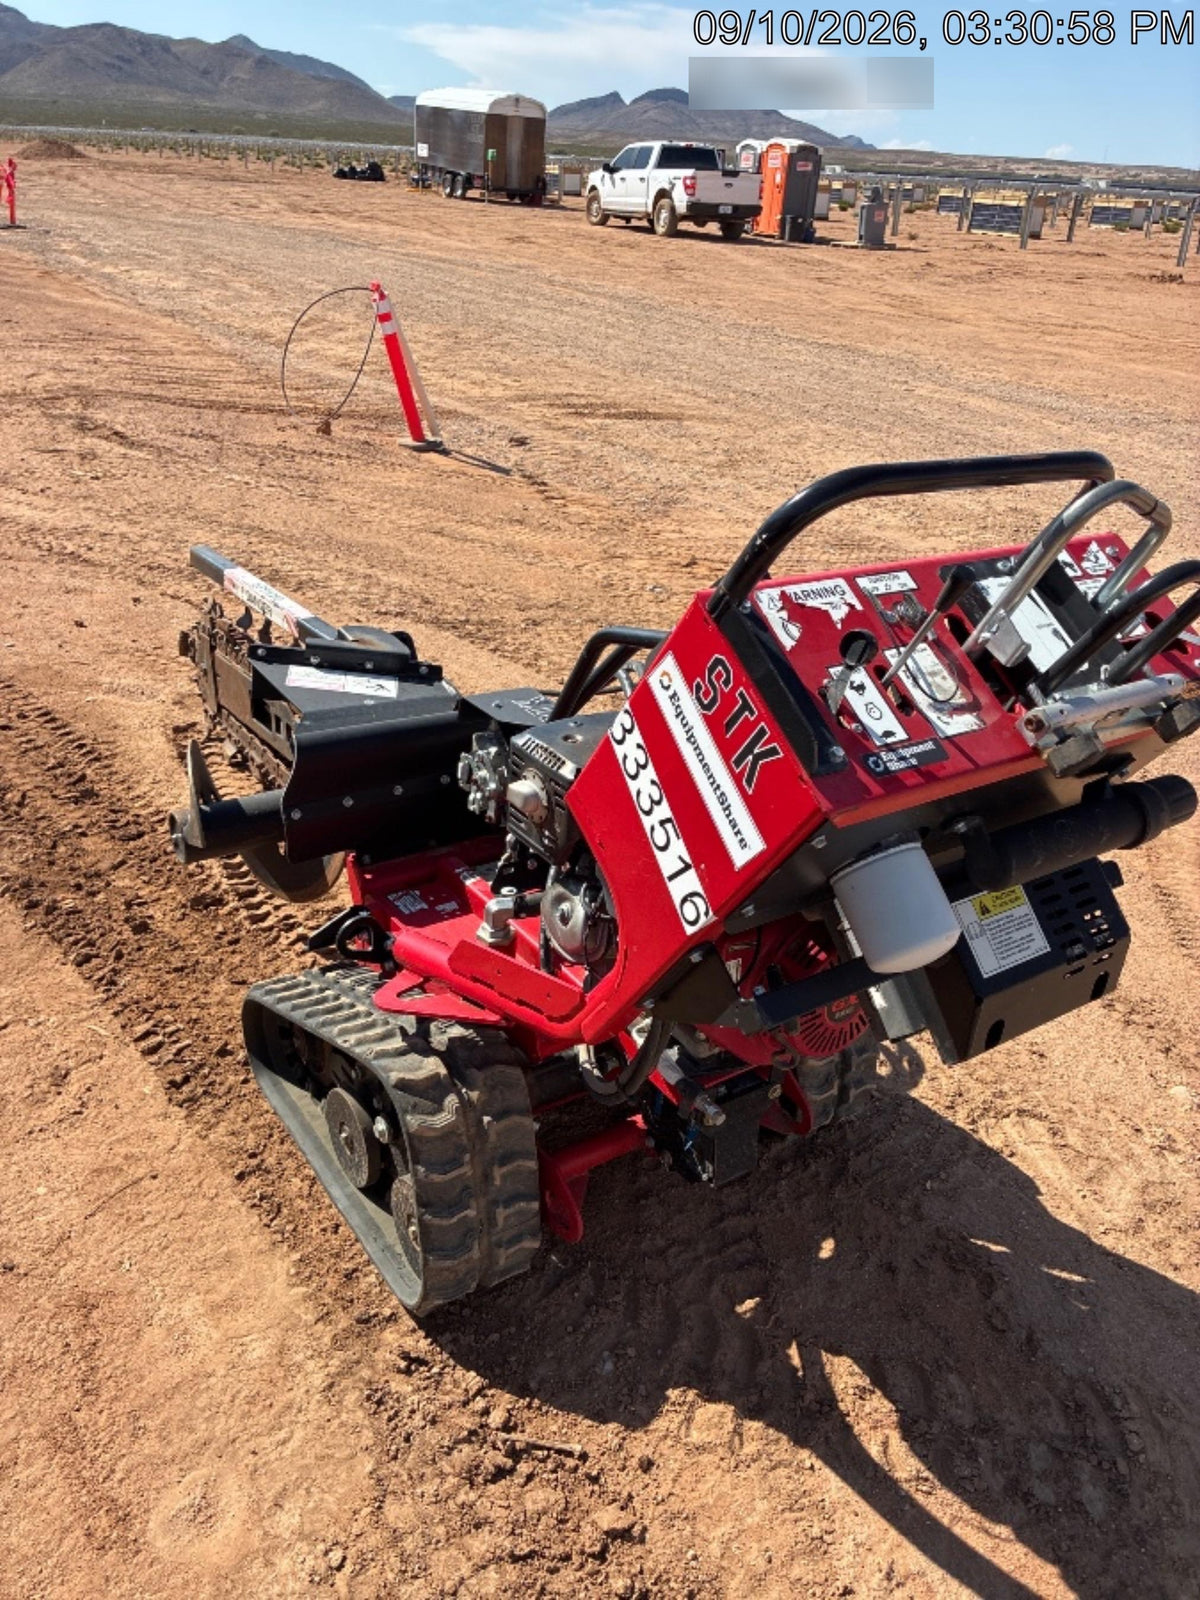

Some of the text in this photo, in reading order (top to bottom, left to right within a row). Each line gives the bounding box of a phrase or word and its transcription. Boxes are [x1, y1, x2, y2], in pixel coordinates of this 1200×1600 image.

[788, 584, 846, 602] ARNING
[668, 693, 748, 851] EquipmentShare
[692, 654, 783, 794] STK
[609, 708, 709, 927] 333516
